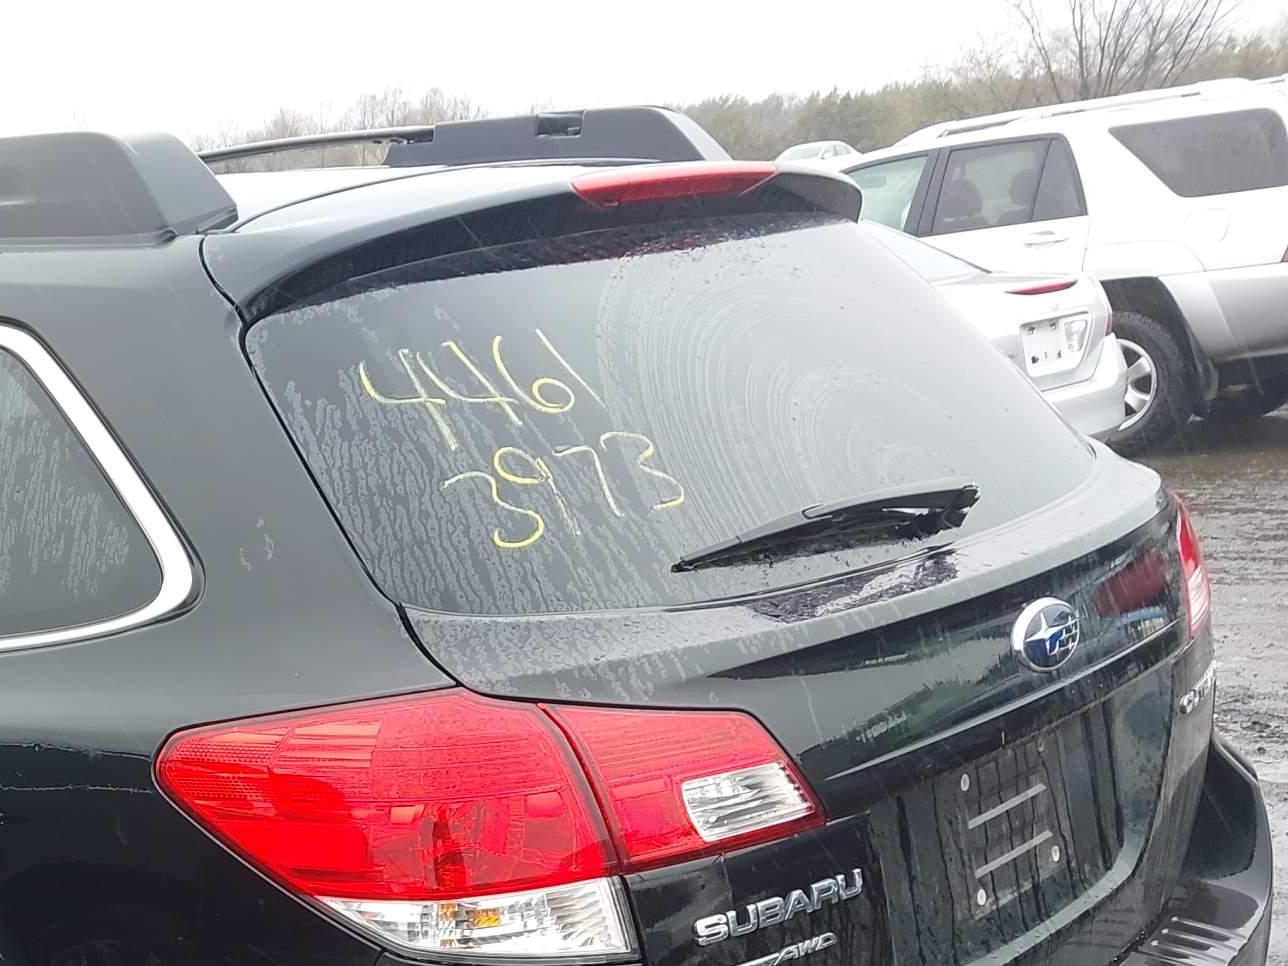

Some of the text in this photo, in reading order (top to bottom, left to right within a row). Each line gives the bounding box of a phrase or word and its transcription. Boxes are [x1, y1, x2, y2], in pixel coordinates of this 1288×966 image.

[358, 328, 607, 451] 4461
[440, 431, 686, 549] 3973
[693, 867, 864, 947] SUBARU
[773, 932, 838, 966] AWD
